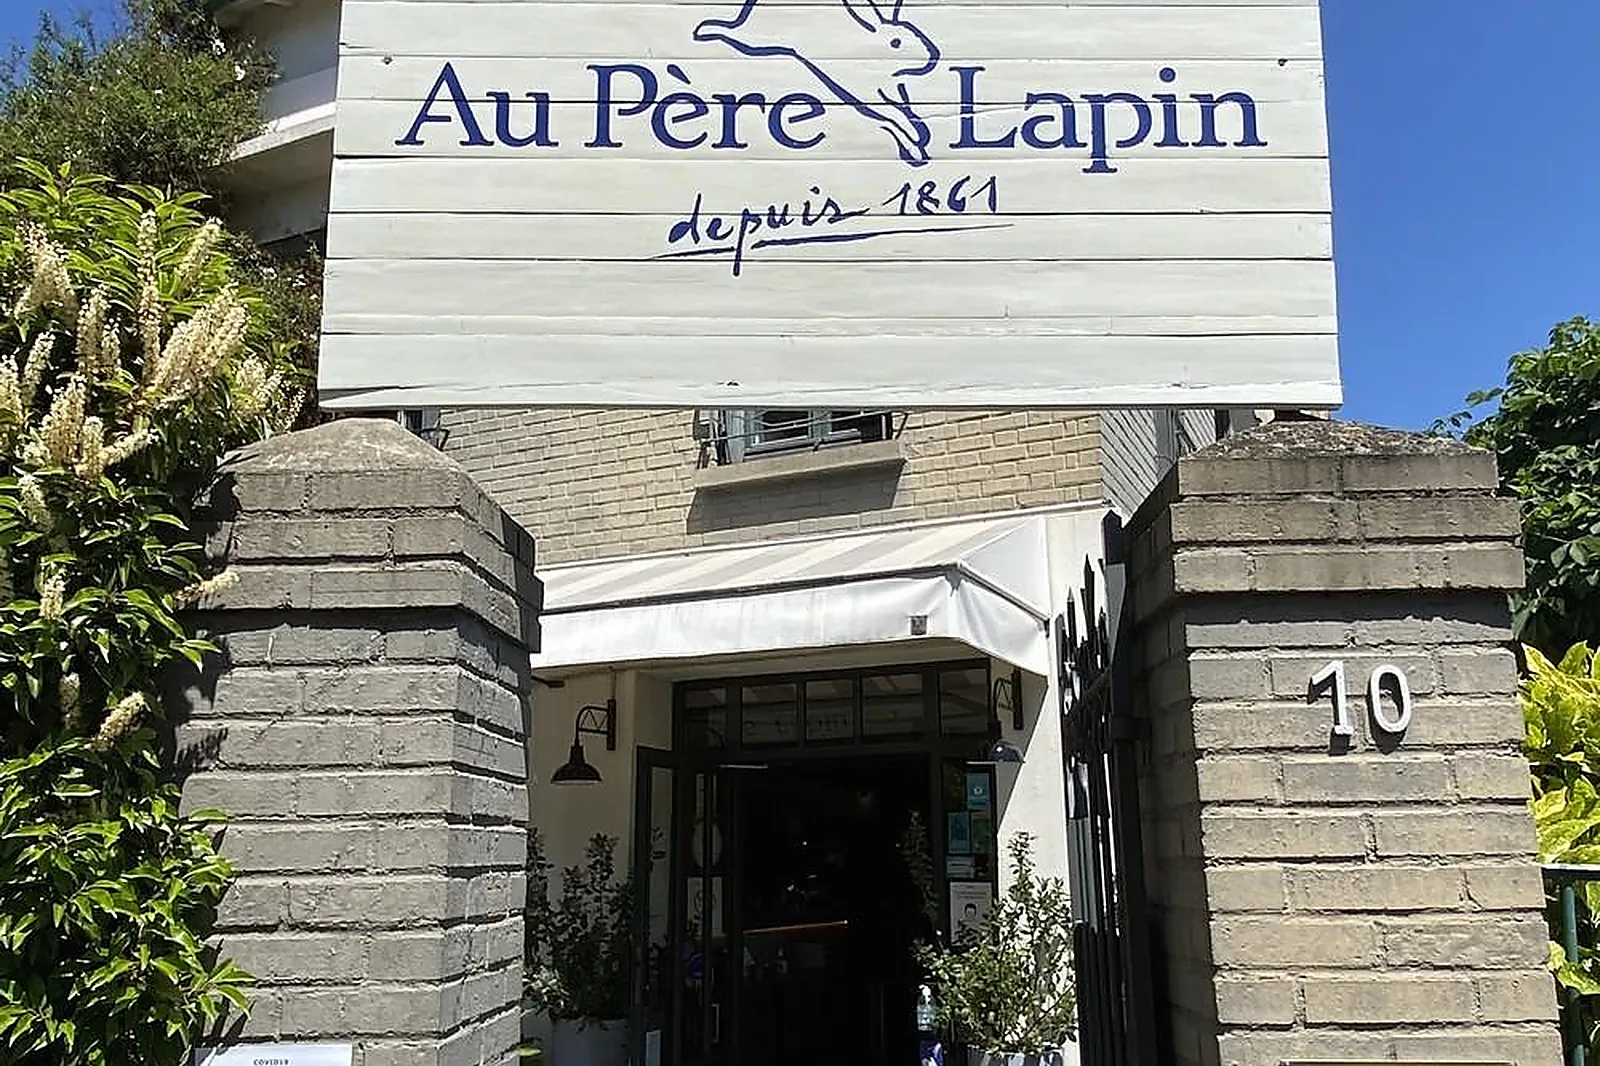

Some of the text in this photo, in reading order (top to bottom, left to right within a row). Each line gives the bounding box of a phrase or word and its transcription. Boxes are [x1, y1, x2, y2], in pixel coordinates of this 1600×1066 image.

[395, 61, 1268, 174] Au Père Lapin
[668, 175, 997, 276] depuis 1861
[1308, 659, 1412, 738] 10
